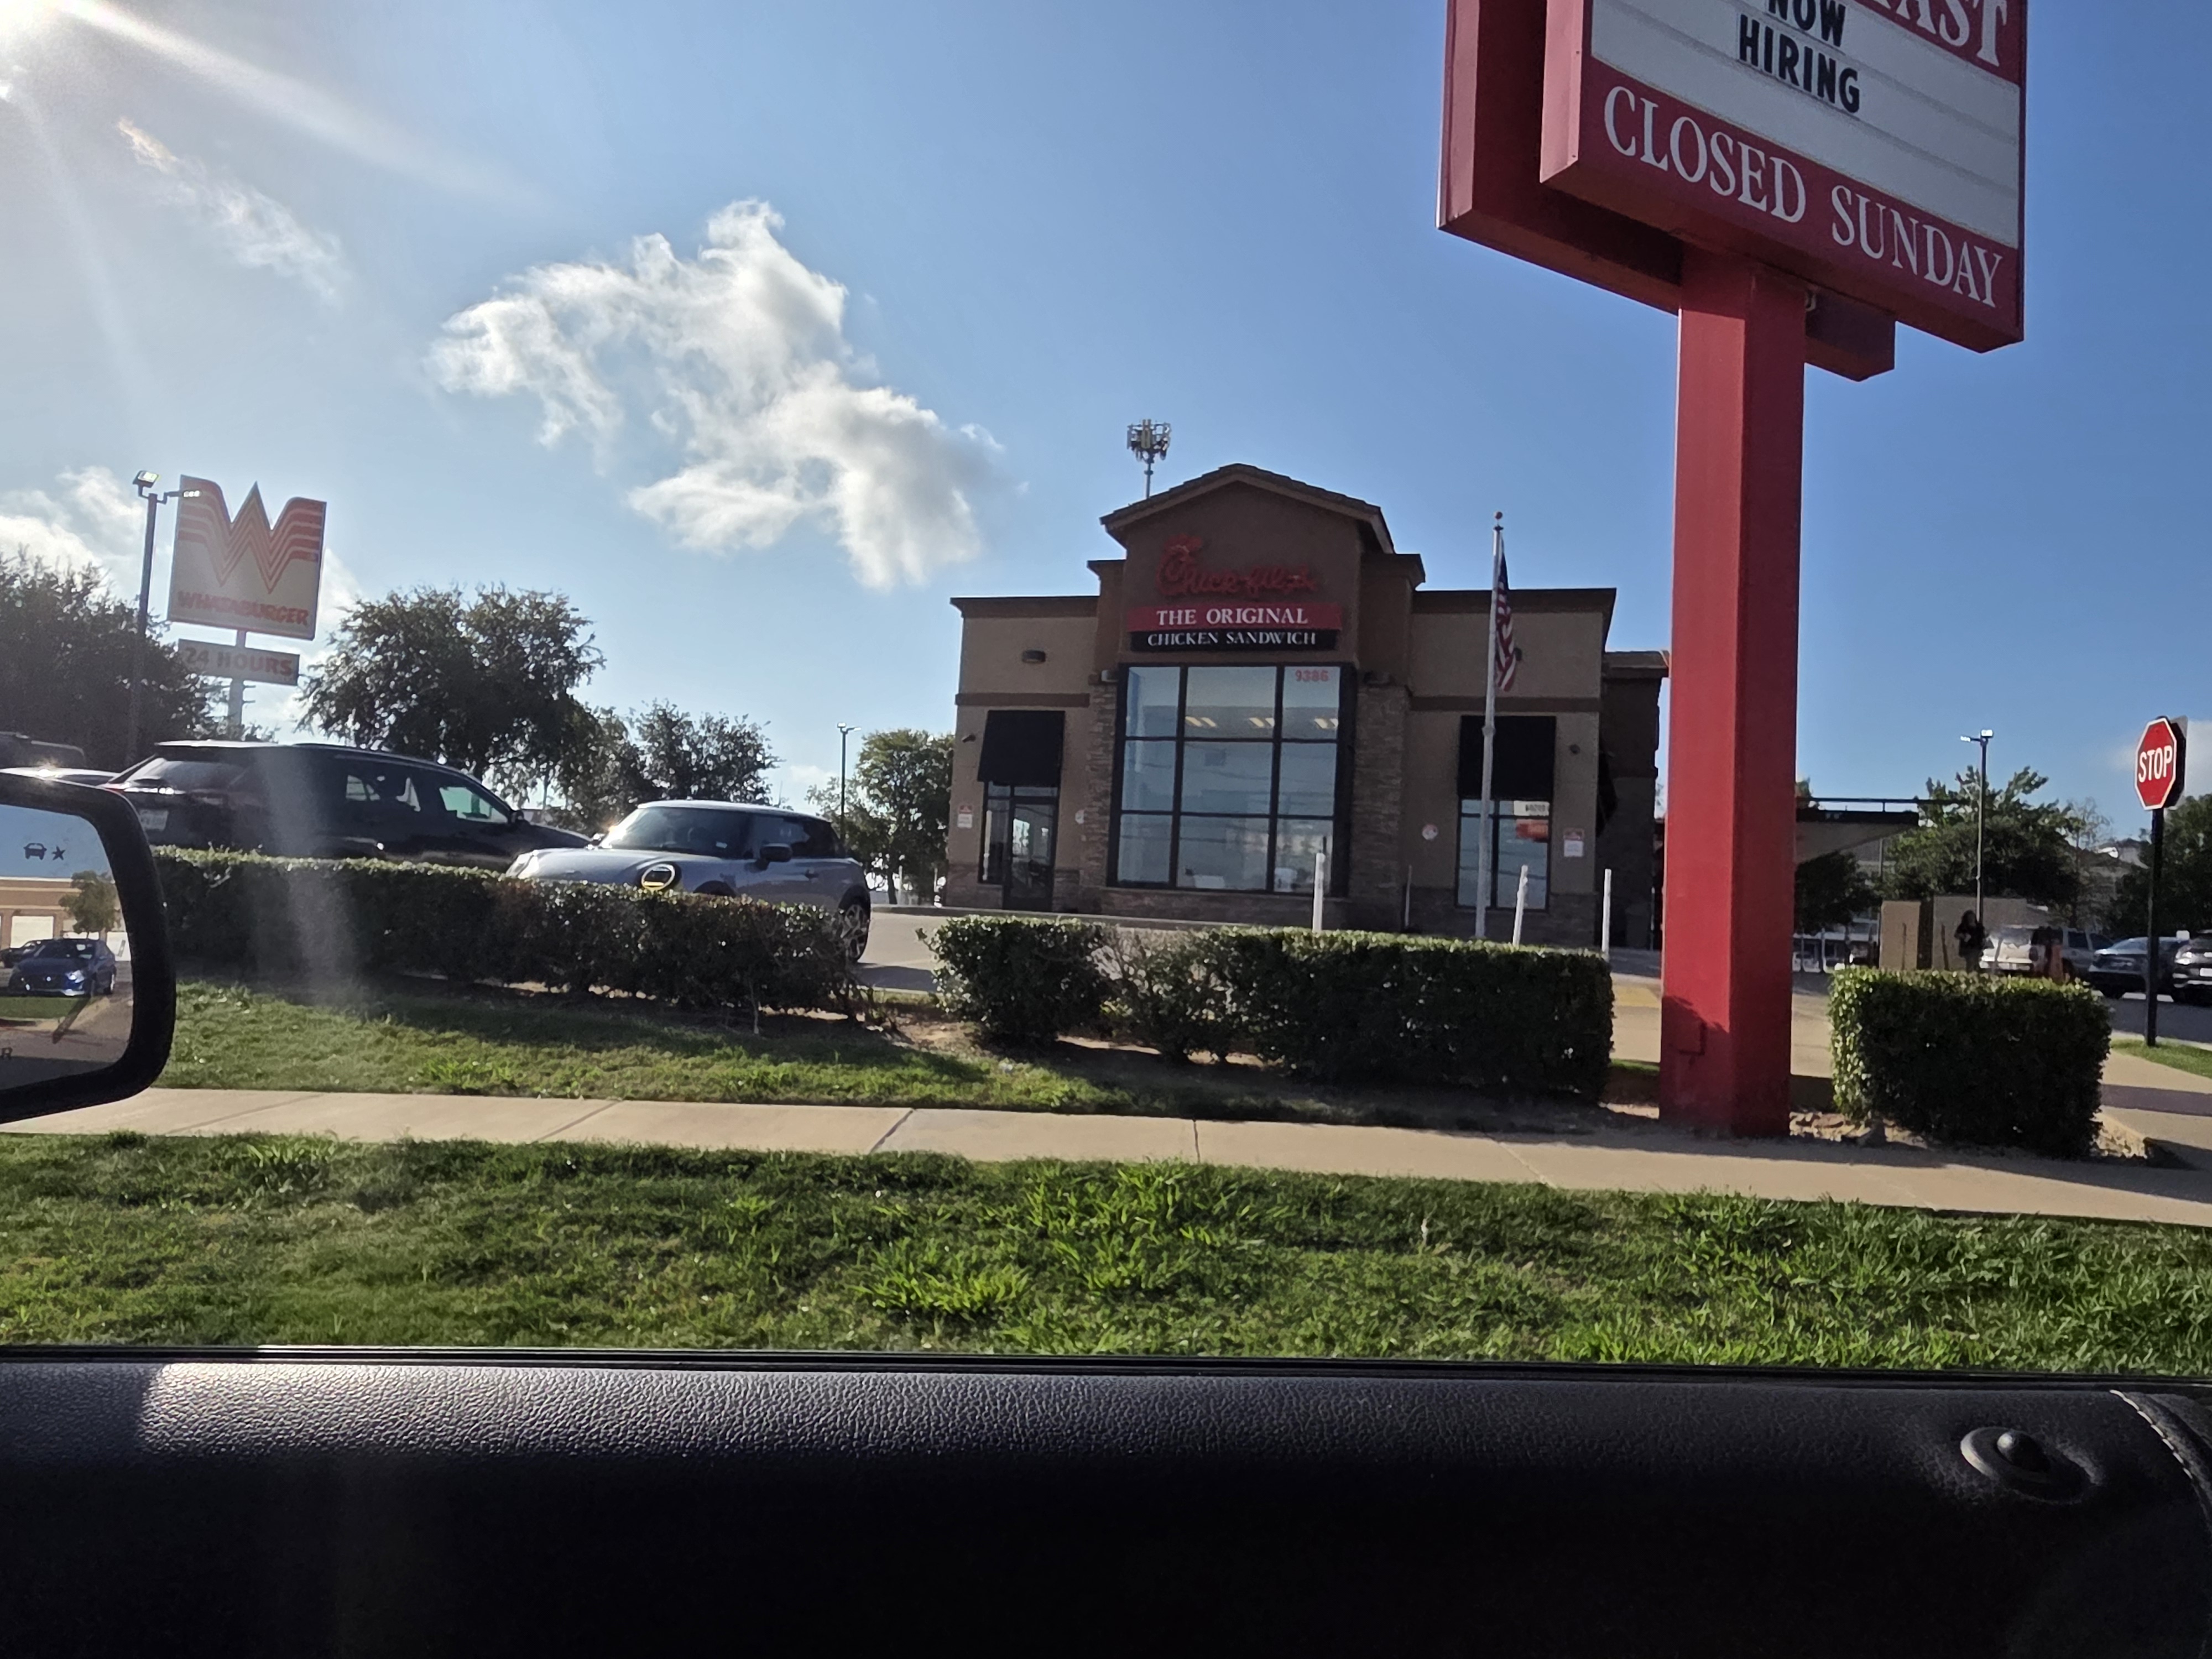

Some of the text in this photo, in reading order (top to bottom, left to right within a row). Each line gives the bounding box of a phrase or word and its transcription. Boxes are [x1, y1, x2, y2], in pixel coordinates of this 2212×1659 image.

[1740, 14, 1860, 113] HIRING
[1604, 86, 2003, 308] CLOSED SUNDAY
[1156, 608, 1308, 626] THE ORIGINAL
[1147, 632, 1316, 646] CHICKEN SANDWICH
[184, 646, 293, 676] 24 HOURS
[2138, 745, 2173, 782] STOP
